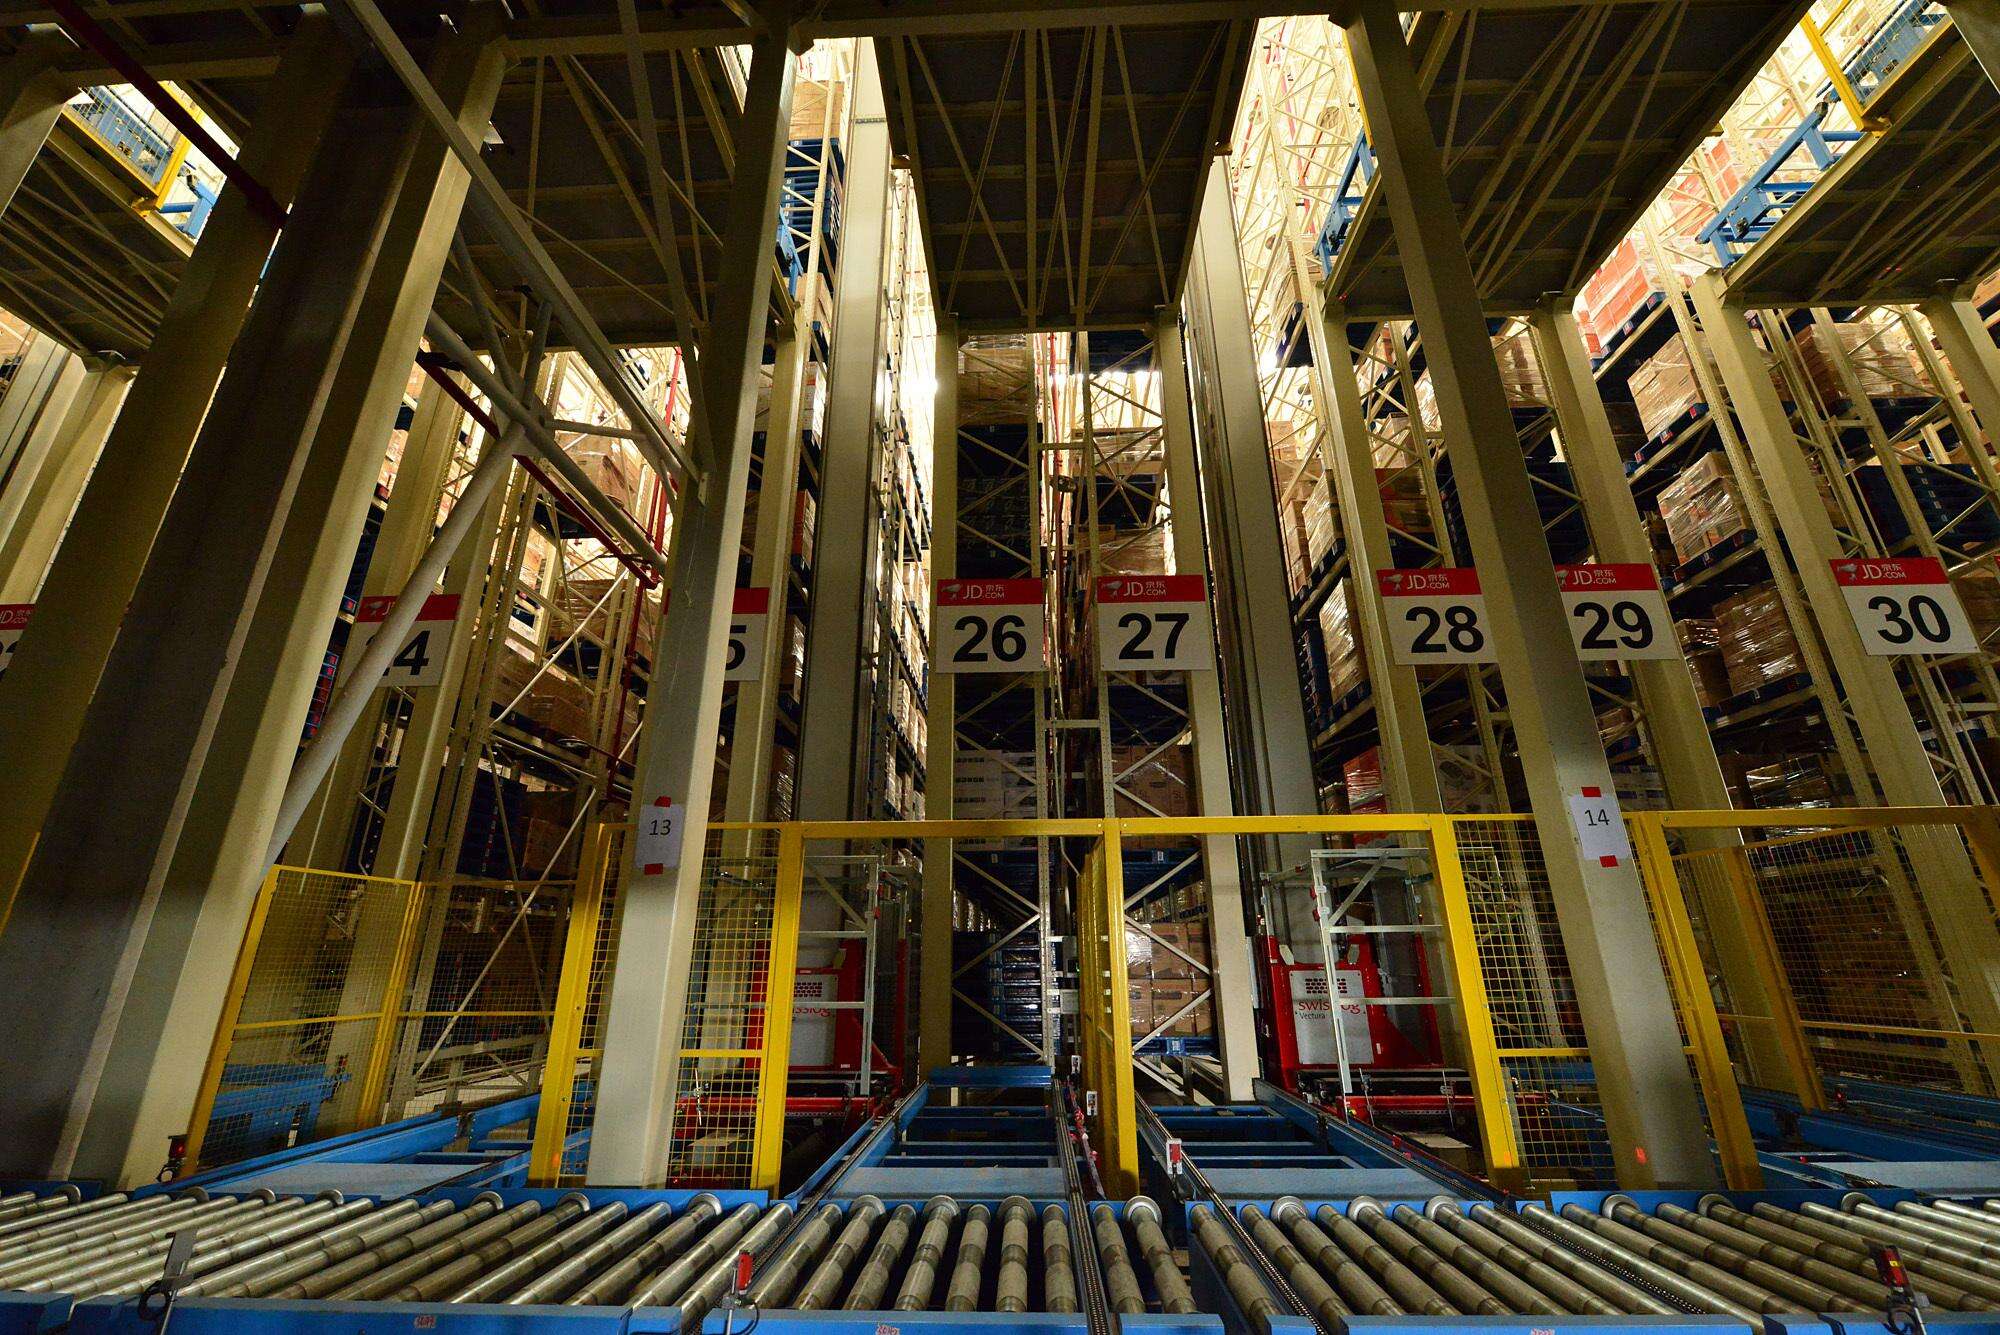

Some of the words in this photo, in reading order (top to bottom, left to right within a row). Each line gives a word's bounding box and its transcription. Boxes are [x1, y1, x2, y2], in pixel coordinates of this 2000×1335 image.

[953, 615, 1027, 662] 26
[1118, 613, 1190, 660] 27
[1405, 605, 1484, 653] 28
[1573, 601, 1653, 649] 29
[1868, 595, 1951, 644] 30
[724, 625, 747, 670] 5
[649, 819, 671, 836] 13
[1584, 808, 1610, 826] 14
[1299, 999, 1360, 1015] swisog
[1299, 1012, 1326, 1020] Vectura
